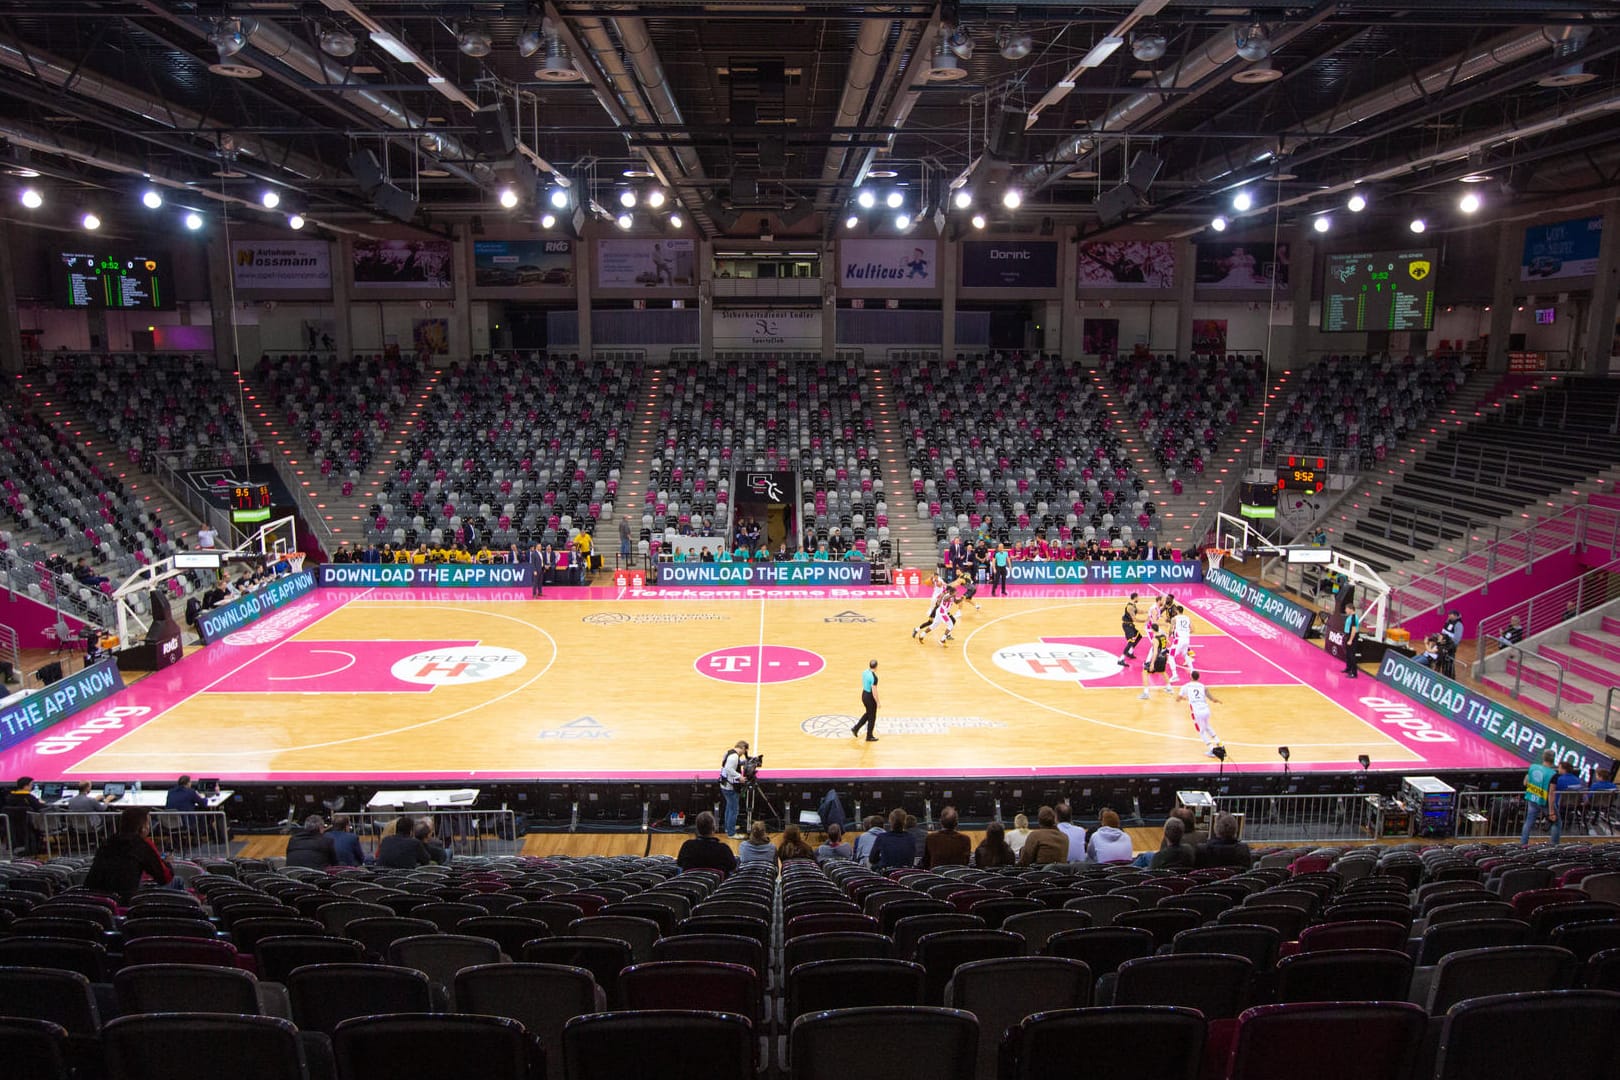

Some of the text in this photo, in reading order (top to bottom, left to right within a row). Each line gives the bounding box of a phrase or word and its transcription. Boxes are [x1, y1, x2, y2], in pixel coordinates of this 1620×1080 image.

[256, 248, 297, 257] Autohaus
[990, 250, 1031, 260] Dorint
[101, 261, 119, 270] 9:52
[846, 263, 904, 280] Kulticus
[1294, 471, 1314, 482] 9:52
[325, 569, 525, 582] DOWNLOAD THE APP NOW
[663, 567, 864, 581] DOWNLOAD THE APP NOW
[1092, 566, 1122, 578] THE
[1126, 566, 1157, 578] APP
[1160, 565, 1194, 578] NOW
[629, 588, 901, 598] Telekom Dome Bonn
[1206, 568, 1248, 600] DOWNLOAD
[1248, 587, 1266, 608] THE
[1264, 598, 1283, 616] APP
[1283, 607, 1306, 630] NOW
[204, 598, 260, 637] DOWNLOAD
[260, 589, 279, 609] THE
[280, 583, 295, 601] APP
[294, 572, 314, 591] NOW
[1179, 620, 1188, 628] 12
[162, 637, 179, 655] RKG
[410, 654, 520, 663] PFLEGE
[415, 662, 494, 678] HR
[1192, 689, 1200, 698] 2
[0, 666, 114, 736] THE APP NOW
[1384, 658, 1466, 714] DOWNLOAD
[1468, 700, 1504, 734] THE
[1502, 720, 1547, 754] APP
[1358, 696, 1457, 743] dhpg
[34, 705, 152, 755] dhpg
[538, 730, 616, 739] PEAK
